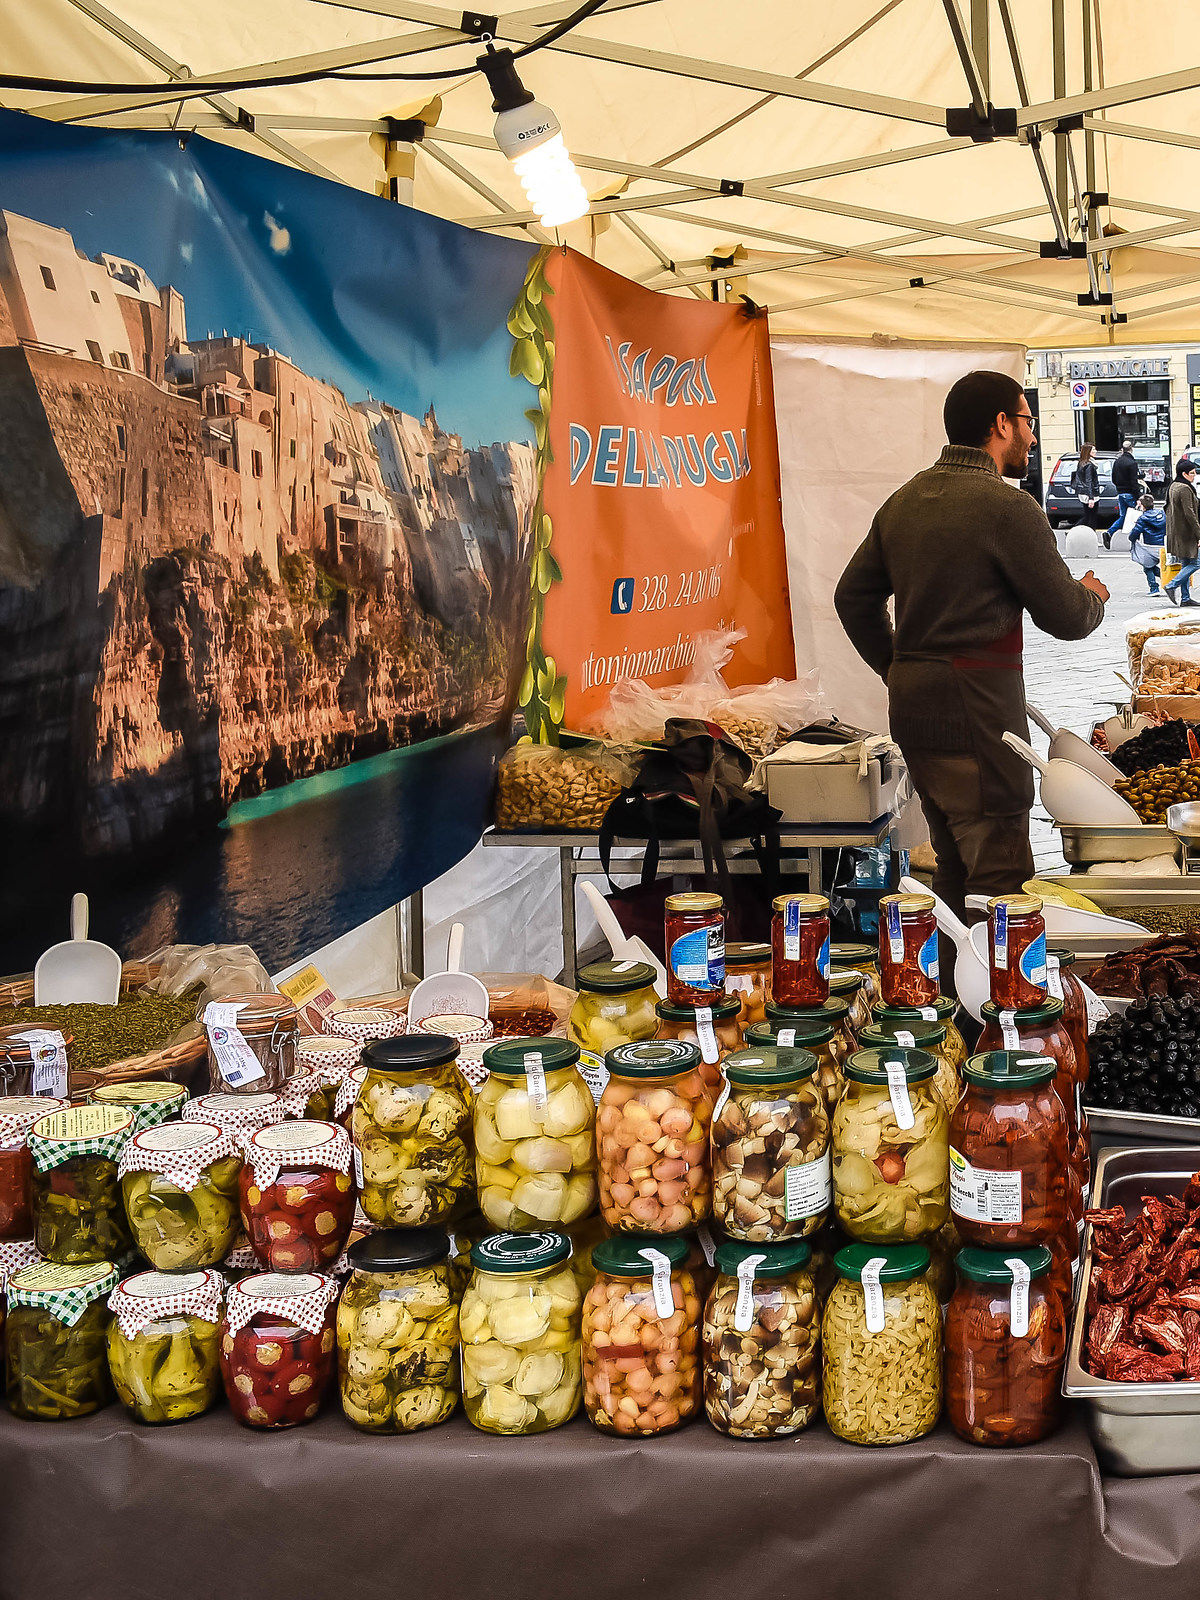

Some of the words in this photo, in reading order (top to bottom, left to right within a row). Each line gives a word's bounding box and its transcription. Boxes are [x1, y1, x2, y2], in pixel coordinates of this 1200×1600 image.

[1070, 361, 1103, 378] BAR
[1104, 359, 1170, 377] DUCALE
[740, 1279, 752, 1318] Garanzia
